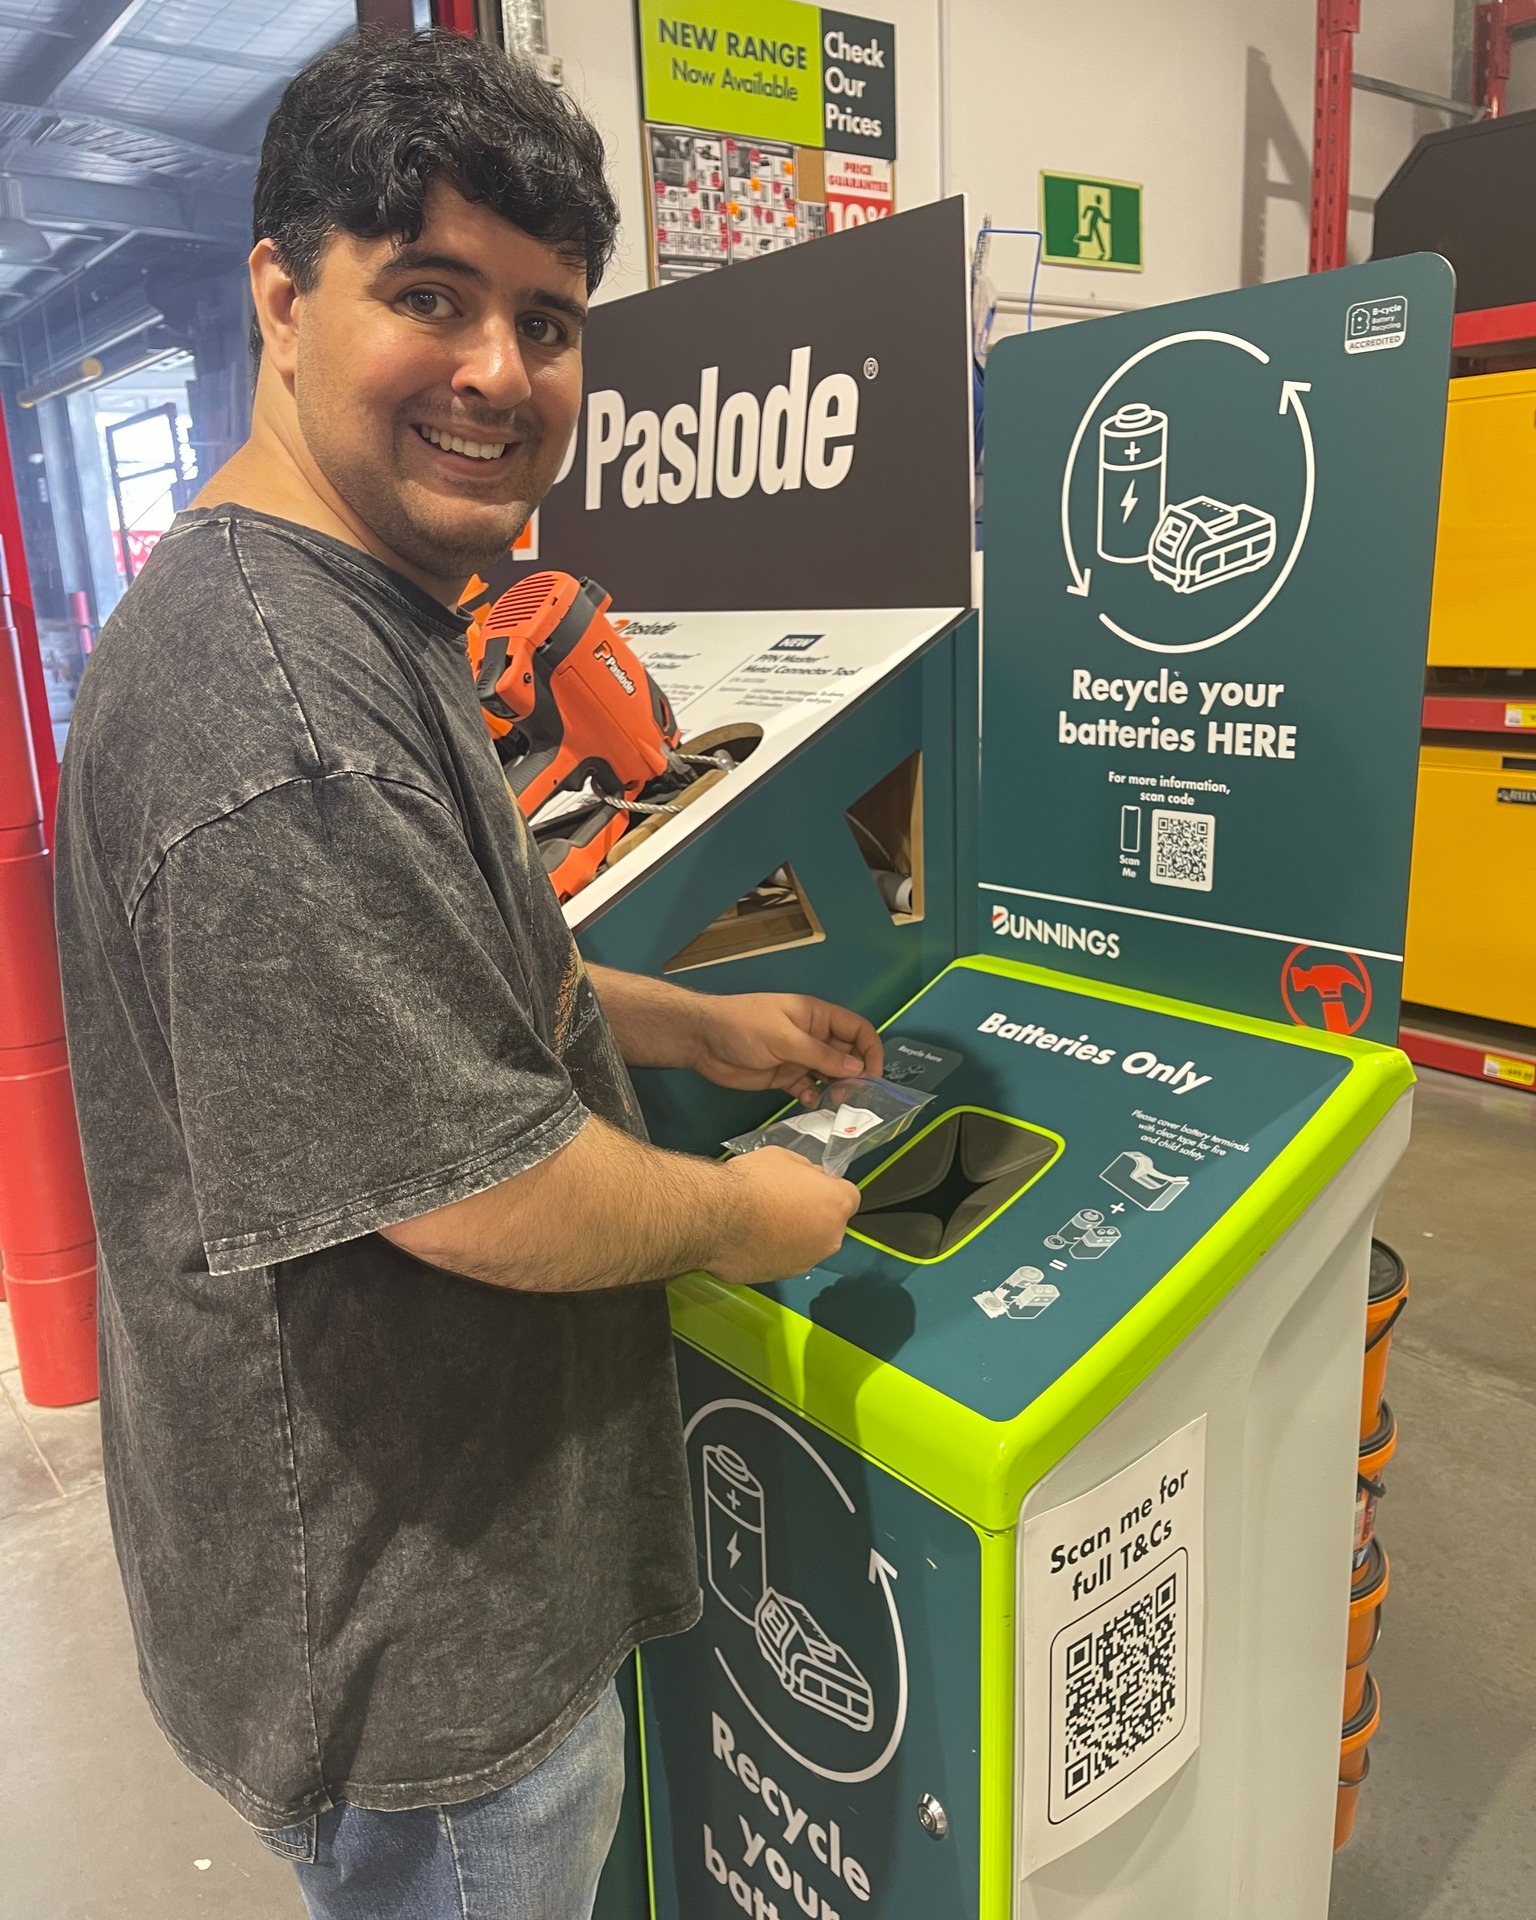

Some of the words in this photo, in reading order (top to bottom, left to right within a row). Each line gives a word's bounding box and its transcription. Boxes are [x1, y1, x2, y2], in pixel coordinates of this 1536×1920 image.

[658, 18, 718, 52] NEW
[726, 31, 808, 70] RANGE
[824, 31, 886, 69] Check
[671, 58, 716, 87] Now
[721, 67, 799, 102] Available
[824, 66, 867, 99] Our
[825, 103, 883, 138] Prices
[1349, 335, 1401, 350] ACCREDITED
[605, 656, 635, 695] Paslode
[1072, 668, 1189, 711] Recycle
[1198, 682, 1285, 715] your
[1058, 711, 1196, 752] batteries
[1207, 721, 1297, 759] HERE
[1108, 771, 1126, 784] For
[1128, 774, 1157, 787] more
[1159, 774, 1231, 796] information,
[1140, 791, 1165, 803] scan
[1168, 792, 1195, 806] code
[1119, 854, 1141, 867] Scan
[1122, 866, 1137, 878] Me
[991, 905, 1120, 960] BUNNINGS
[977, 1011, 1116, 1066] Batteries
[1120, 1050, 1213, 1095] Only
[1131, 1109, 1158, 1123] Please
[1157, 1119, 1181, 1130] cover
[1180, 1123, 1211, 1140] battery
[1210, 1135, 1250, 1153] terminals
[1138, 1123, 1155, 1133] with
[1155, 1128, 1178, 1139] clear
[1176, 1135, 1197, 1148] tape
[1197, 1140, 1211, 1150] for
[1210, 1144, 1227, 1157] fire
[1140, 1134, 1160, 1145] and
[1157, 1139, 1181, 1152] child
[1050, 1526, 1111, 1574] Scan
[1120, 1498, 1153, 1534] me
[1159, 1468, 1189, 1505] for
[1072, 1553, 1112, 1602] full
[1120, 1519, 1173, 1571] T&Cs
[711, 1711, 871, 1902] Recycle
